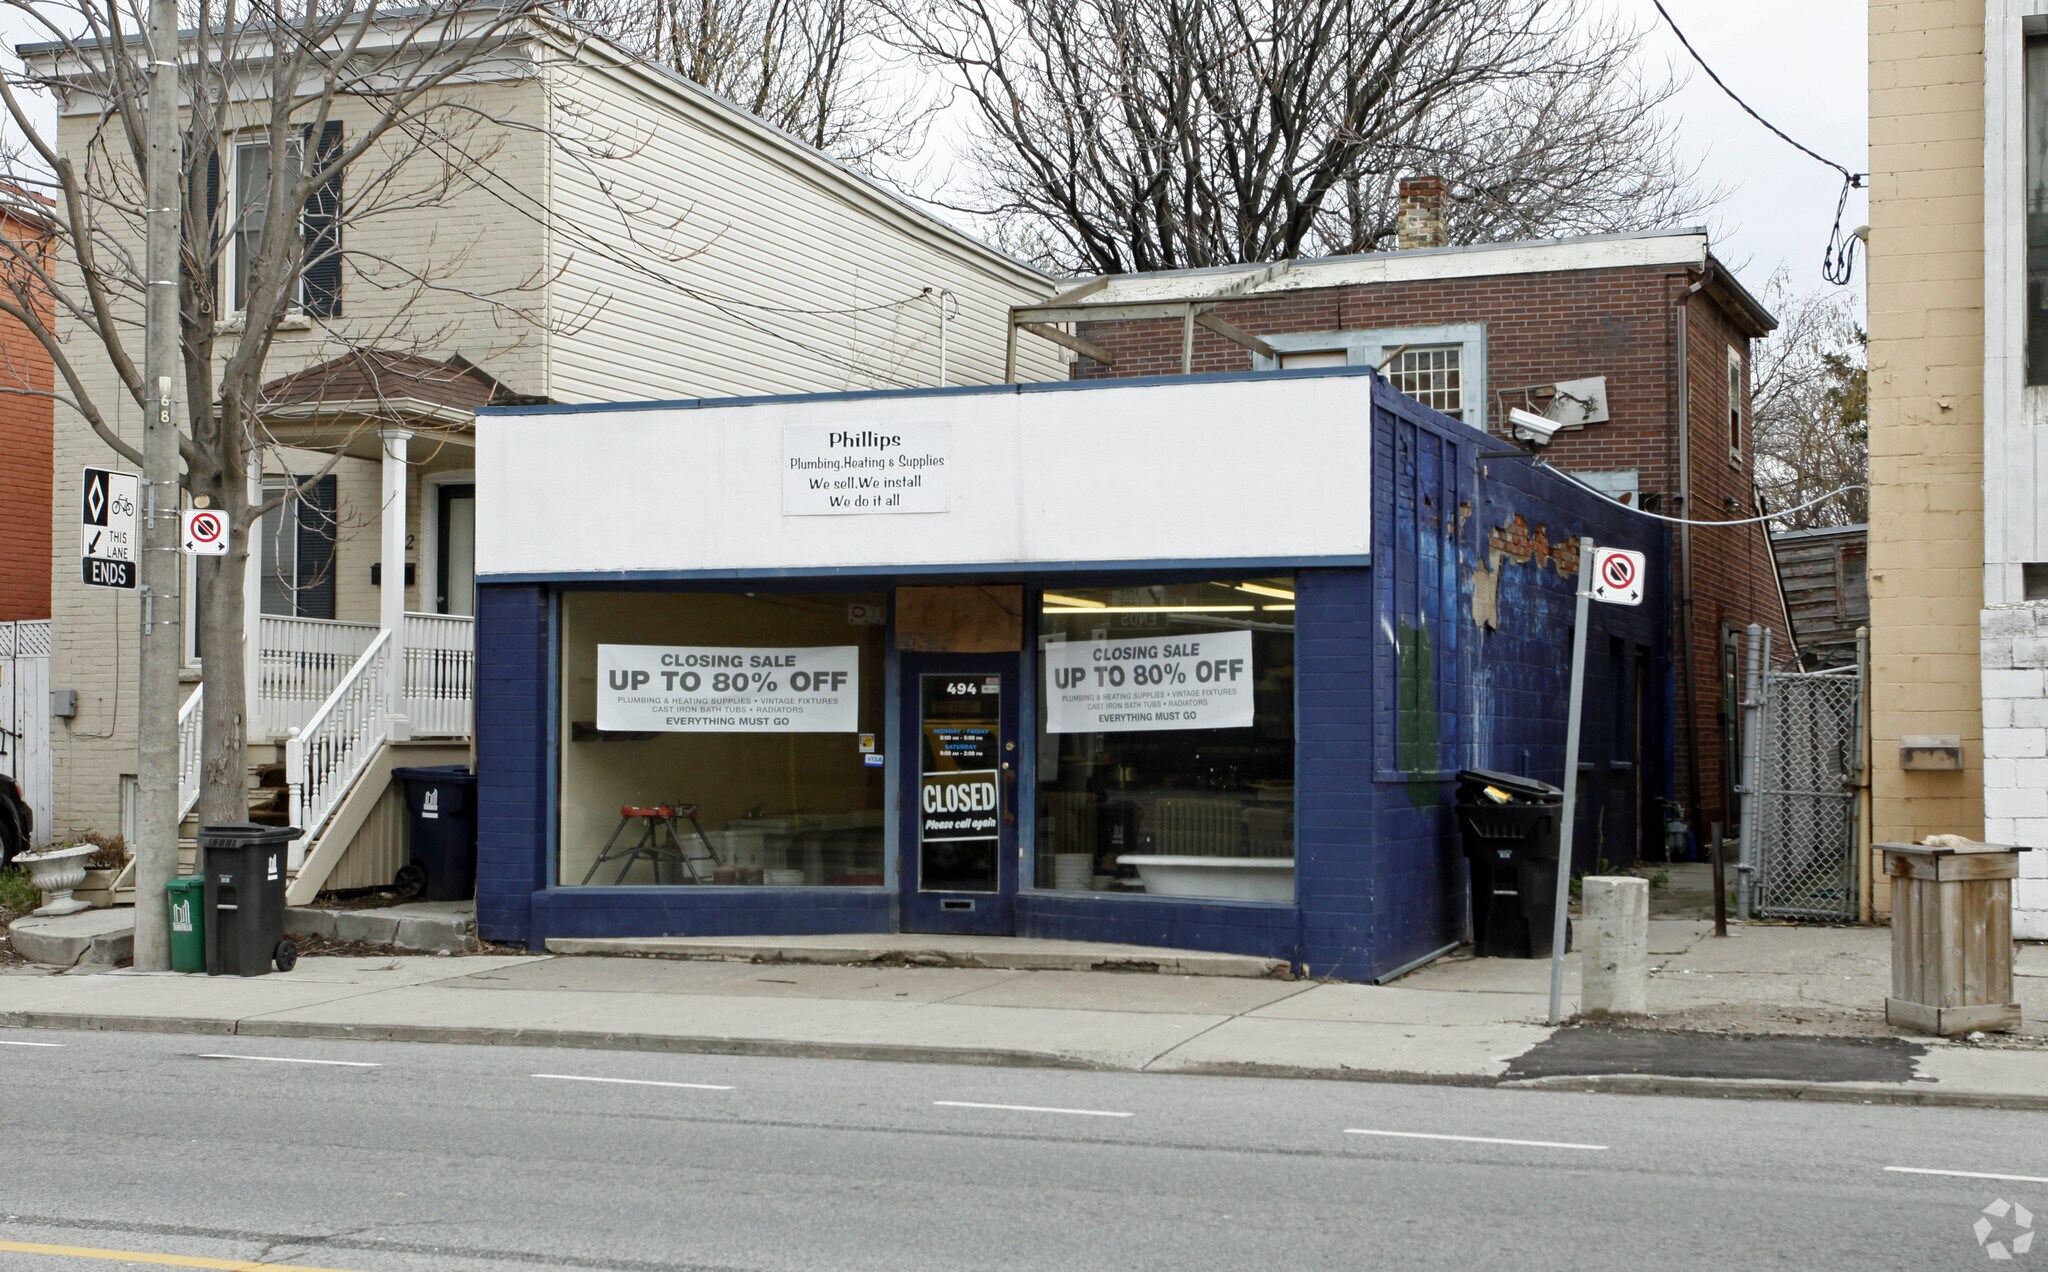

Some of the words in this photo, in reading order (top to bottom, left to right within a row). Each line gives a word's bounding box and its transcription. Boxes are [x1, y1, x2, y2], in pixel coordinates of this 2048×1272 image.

[829, 431, 901, 450] Phillips
[888, 459, 894, 467] &
[898, 453, 945, 470] Supplies
[809, 477, 830, 490] We
[884, 475, 921, 488] install
[829, 495, 851, 507] We
[854, 494, 869, 507] do
[873, 495, 882, 507] it
[885, 493, 900, 506] all
[109, 530, 127, 544] THIS
[106, 545, 128, 560] LANE
[92, 561, 127, 586] ENDS
[1093, 645, 1158, 662] CLOSING
[1163, 643, 1200, 658] SALE
[661, 653, 743, 668] CLOSING
[749, 655, 796, 668] SALE
[609, 669, 650, 691] UP
[660, 671, 702, 692] TO
[711, 671, 778, 693] 80%
[790, 671, 848, 692] OFF
[1055, 667, 1086, 690] UP
[1094, 665, 1126, 688] TO
[1133, 662, 1186, 686] 80%
[1195, 659, 1244, 683] OFF
[946, 683, 977, 695] 494
[1062, 694, 1095, 702] PLUMBING
[1103, 692, 1131, 700] HEATING
[1133, 691, 1165, 699] SUPPLIES
[1172, 689, 1200, 698] VINTAGE
[1202, 688, 1237, 696] FIXTURES
[617, 696, 661, 704] PLUMBING
[1087, 702, 1104, 711] CAST
[1106, 702, 1122, 710] IRON
[1124, 701, 1142, 709] BATH
[1144, 700, 1161, 708] TUBS
[1168, 699, 1208, 707] RADIATORS
[666, 717, 735, 726] EVERYTHING
[739, 717, 770, 726] MUST
[773, 717, 790, 726] GO
[1098, 712, 1153, 722] EVERYTHING
[1155, 711, 1180, 721] MUST
[1183, 710, 1197, 720] GO
[867, 755, 882, 763] VISA
[923, 782, 996, 813] CLOSED
[925, 819, 953, 830] Please
[954, 818, 971, 829] call
[971, 817, 997, 830] again
